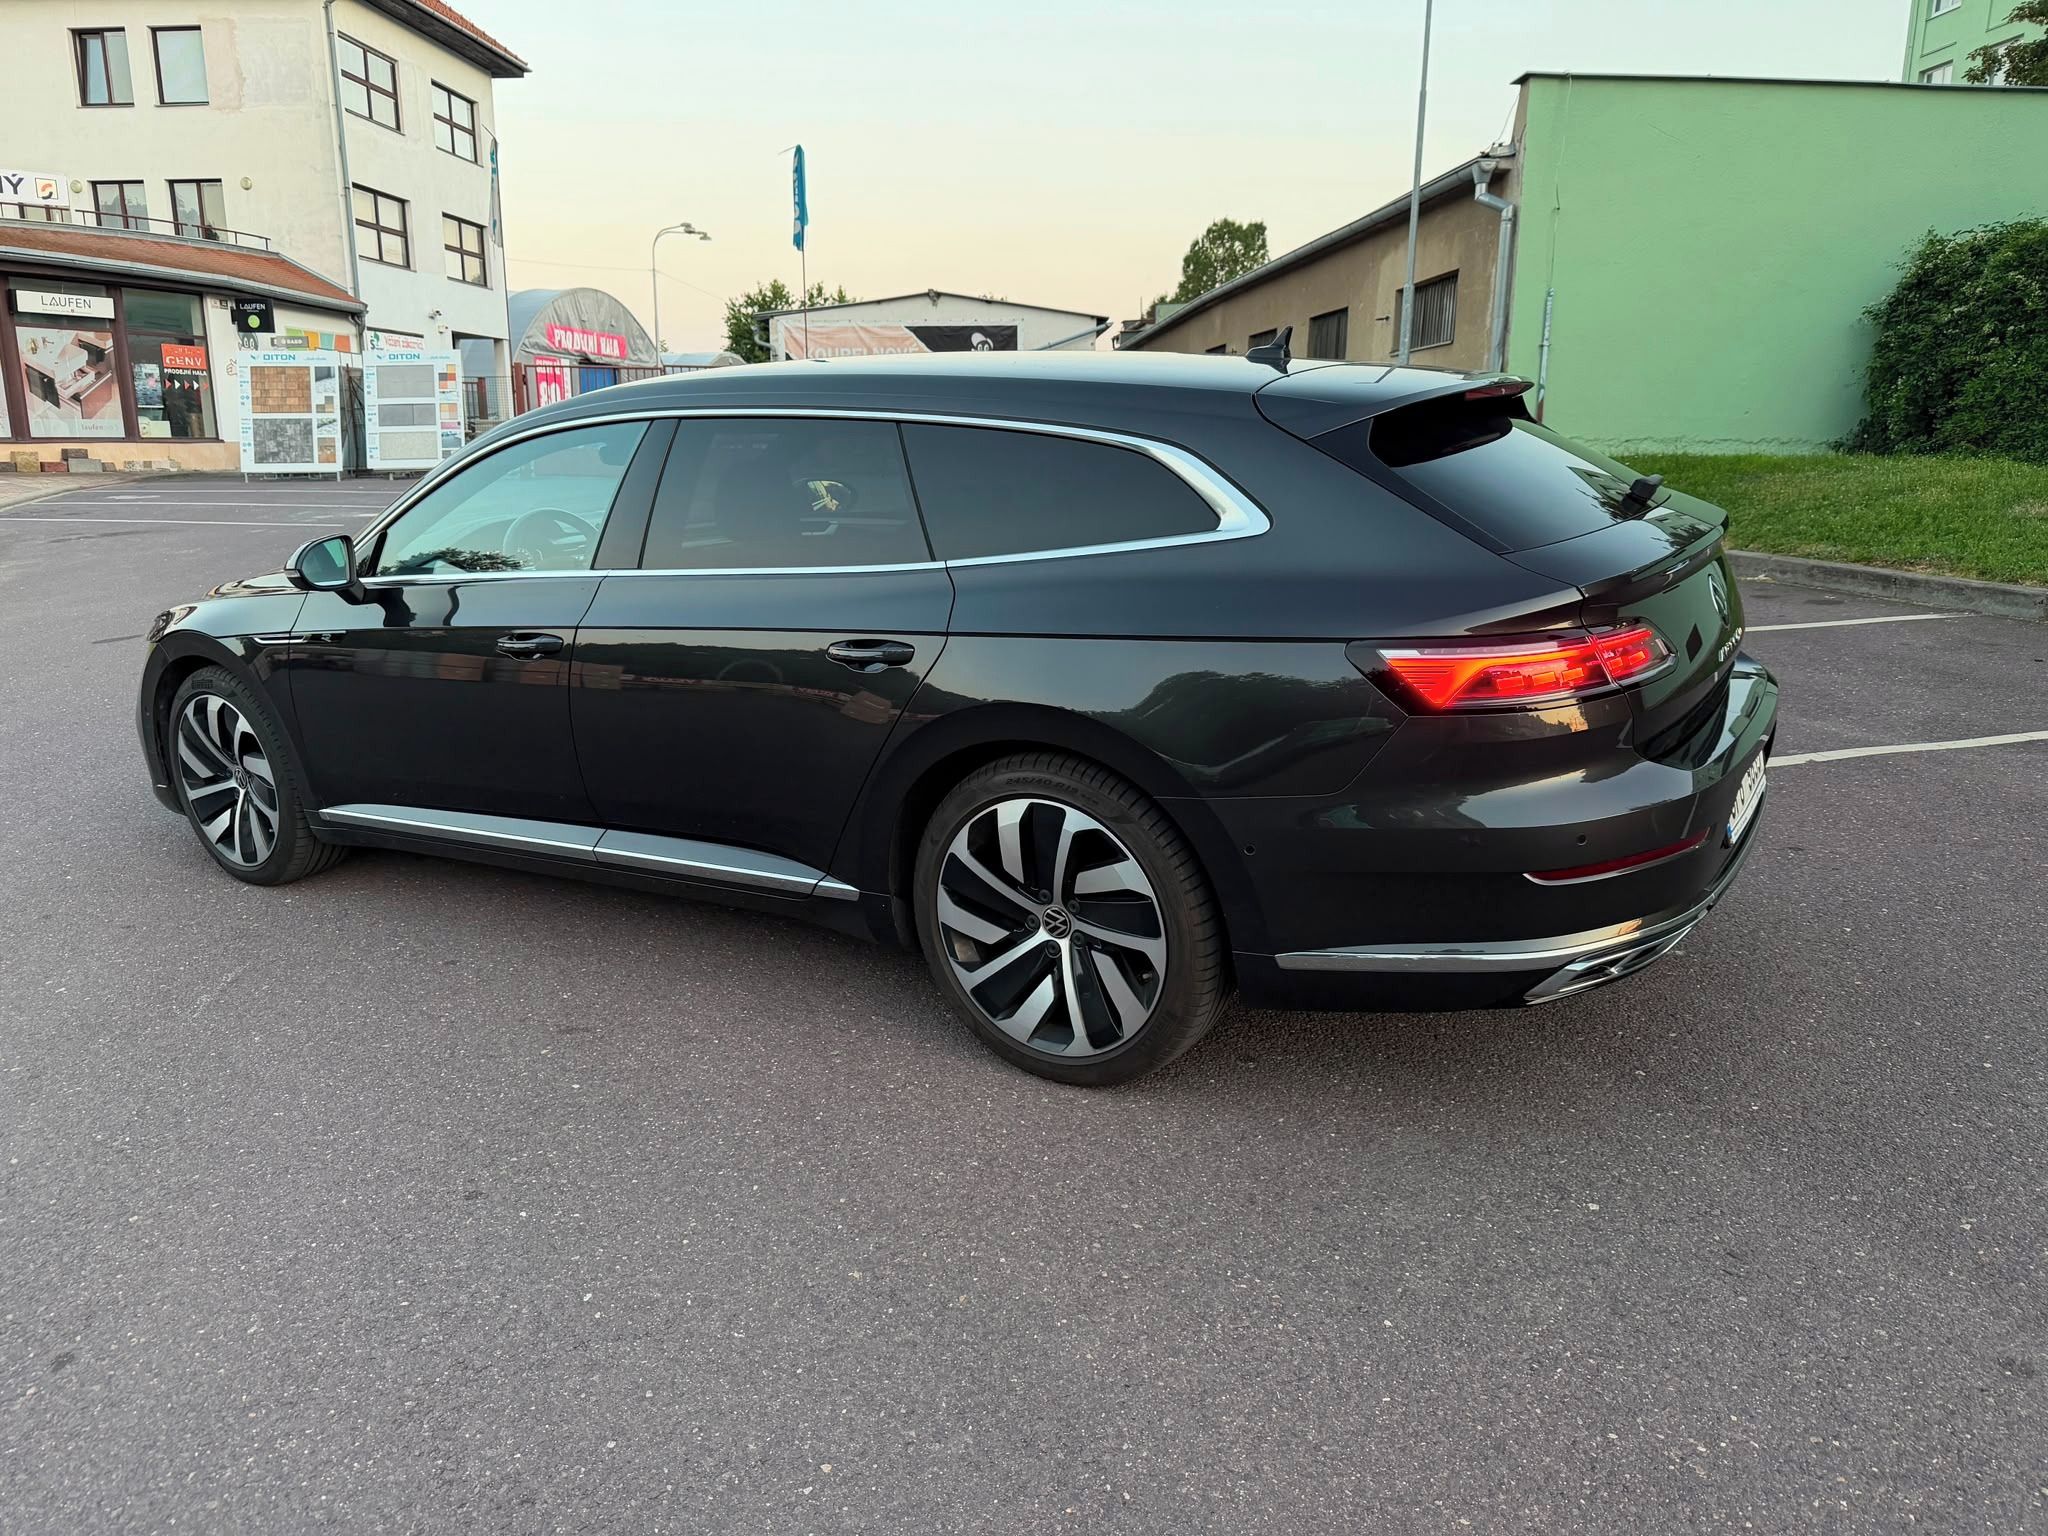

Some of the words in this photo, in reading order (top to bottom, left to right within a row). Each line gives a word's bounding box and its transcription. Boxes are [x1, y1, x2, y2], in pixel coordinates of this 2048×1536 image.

[0, 174, 24, 195] Ý
[41, 295, 92, 309] LAUFEN
[263, 353, 296, 361] DITON
[388, 353, 421, 361] DITON
